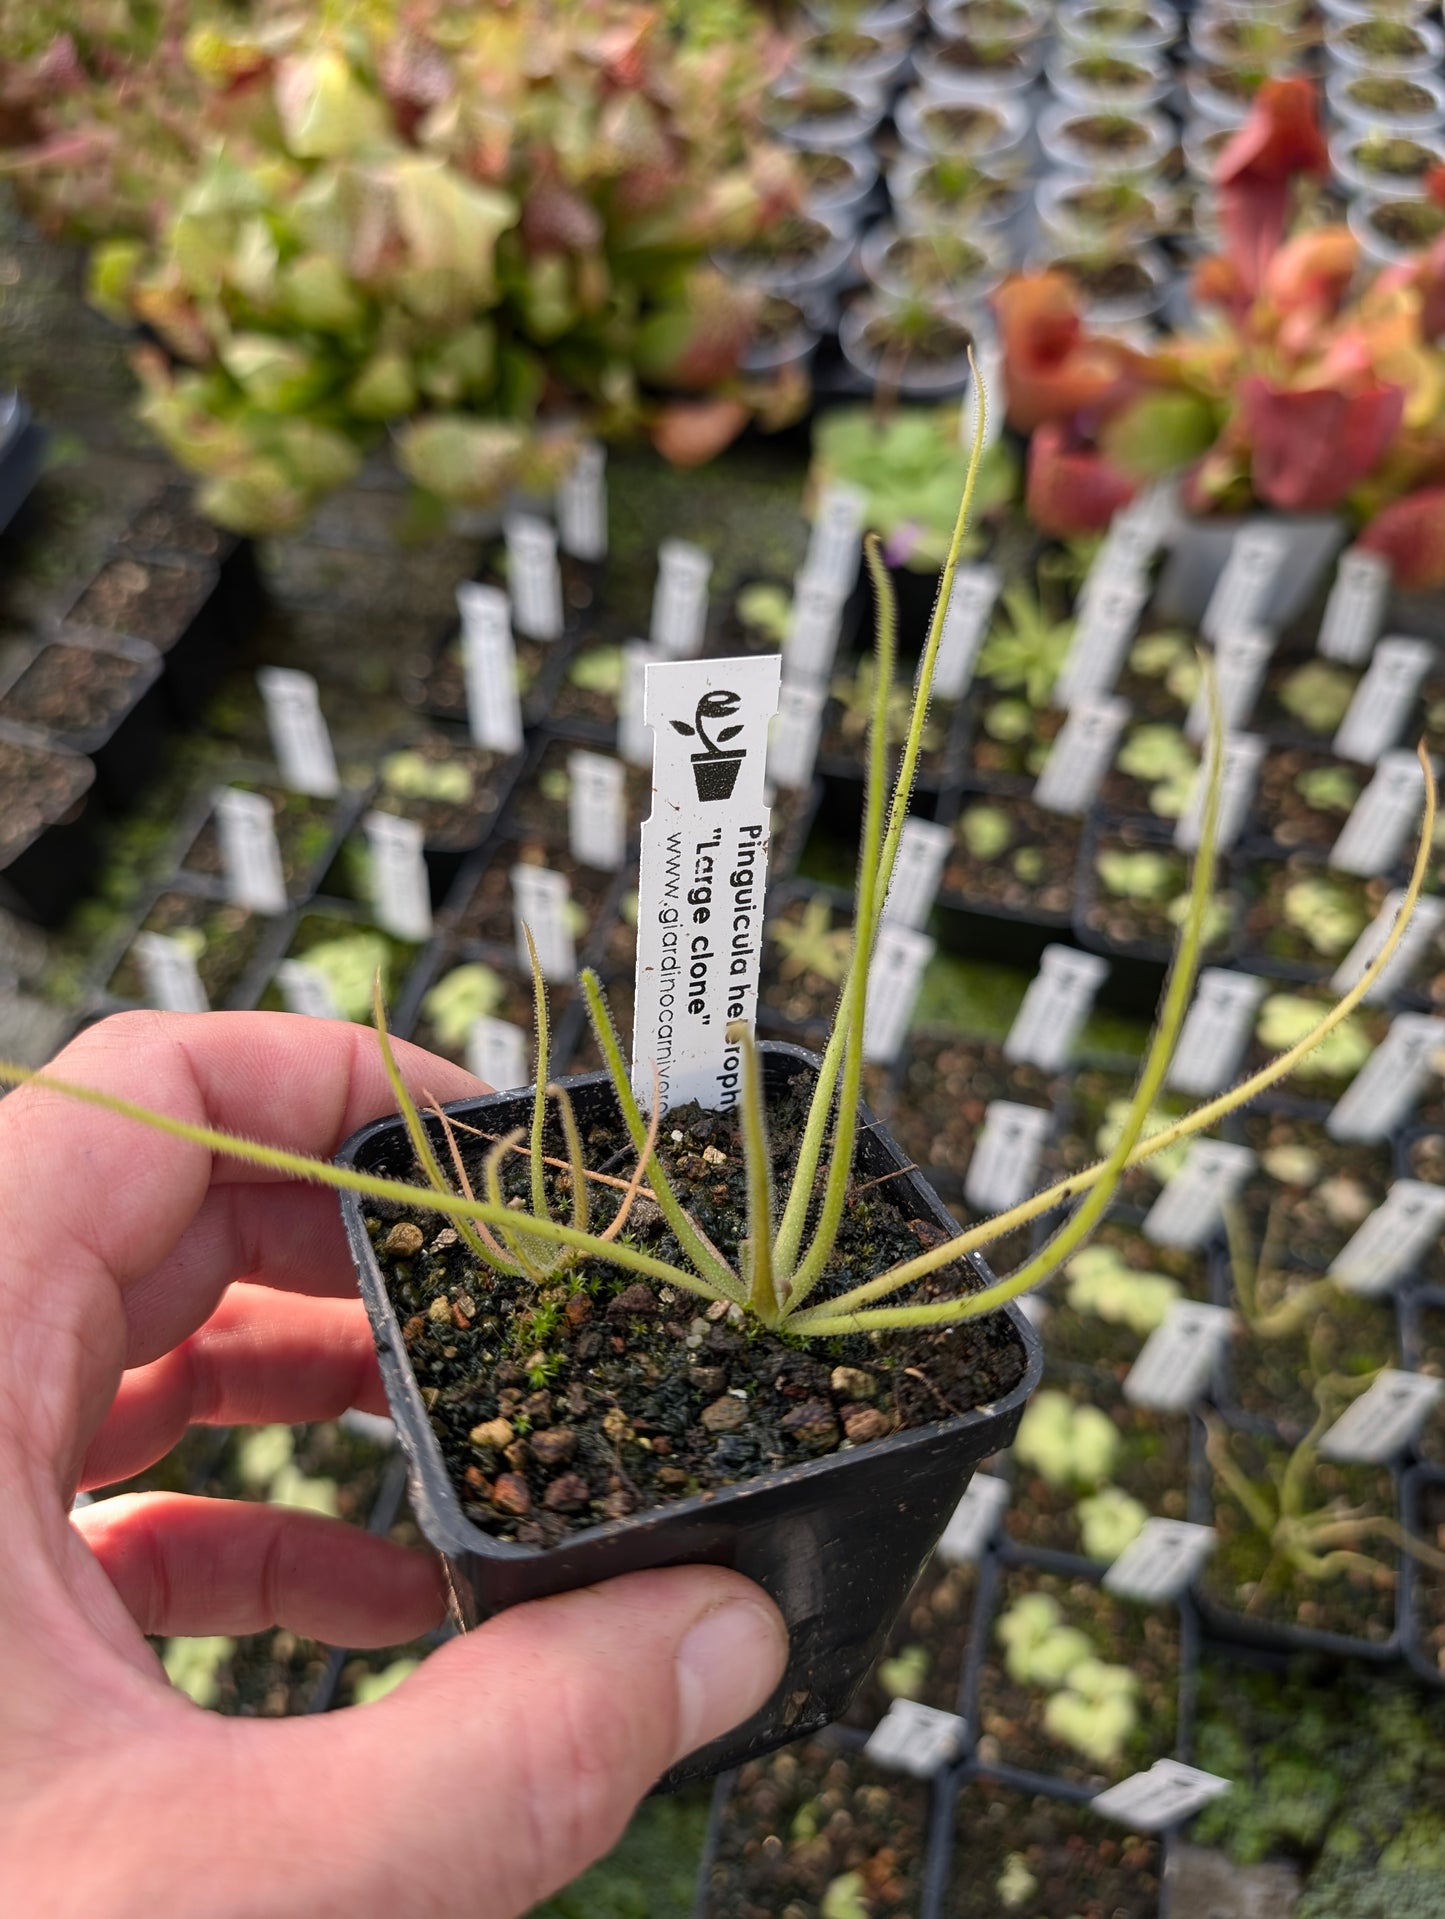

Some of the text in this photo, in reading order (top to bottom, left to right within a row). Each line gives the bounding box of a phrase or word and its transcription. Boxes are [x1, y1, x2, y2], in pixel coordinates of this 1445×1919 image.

[686, 827, 722, 1025] "Large clone"
[729, 824, 763, 976] Pinguicula
